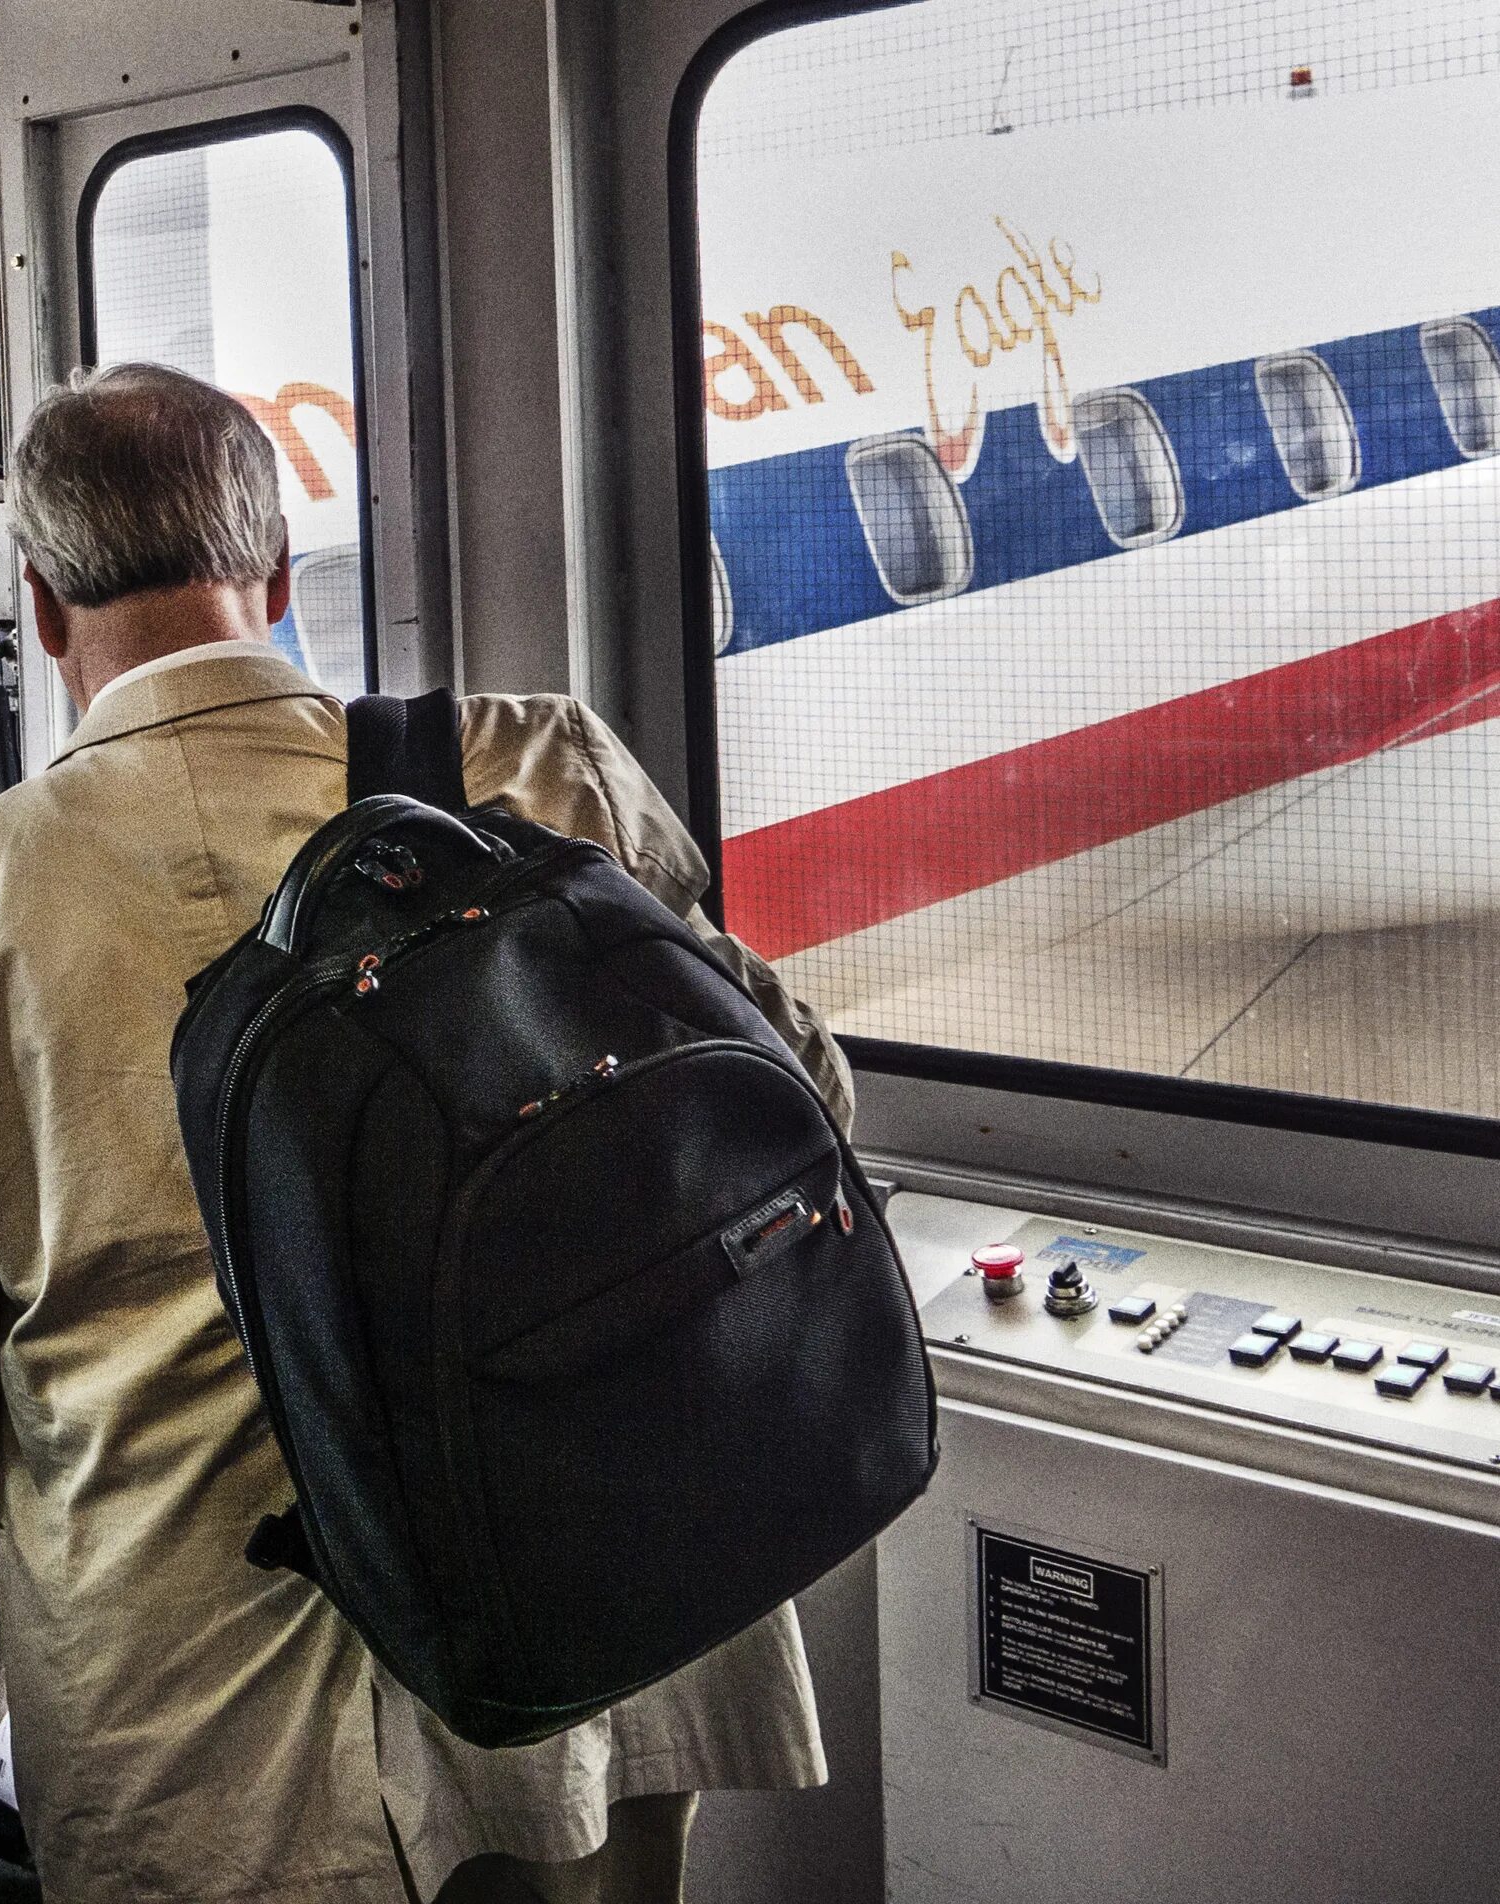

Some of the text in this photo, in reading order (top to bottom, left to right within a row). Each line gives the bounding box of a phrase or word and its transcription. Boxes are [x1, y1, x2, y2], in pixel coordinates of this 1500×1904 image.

[891, 214, 1101, 472] Eagle
[1356, 1306, 1411, 1321] BRIDGE
[1418, 1317, 1439, 1327] TO
[1442, 1321, 1461, 1332] BE
[1035, 1565, 1089, 1590] WARNING
[1000, 1584, 1039, 1600] OPERATORS
[1069, 1596, 1099, 1611] TRAINED
[1047, 1612, 1069, 1625] SPEED
